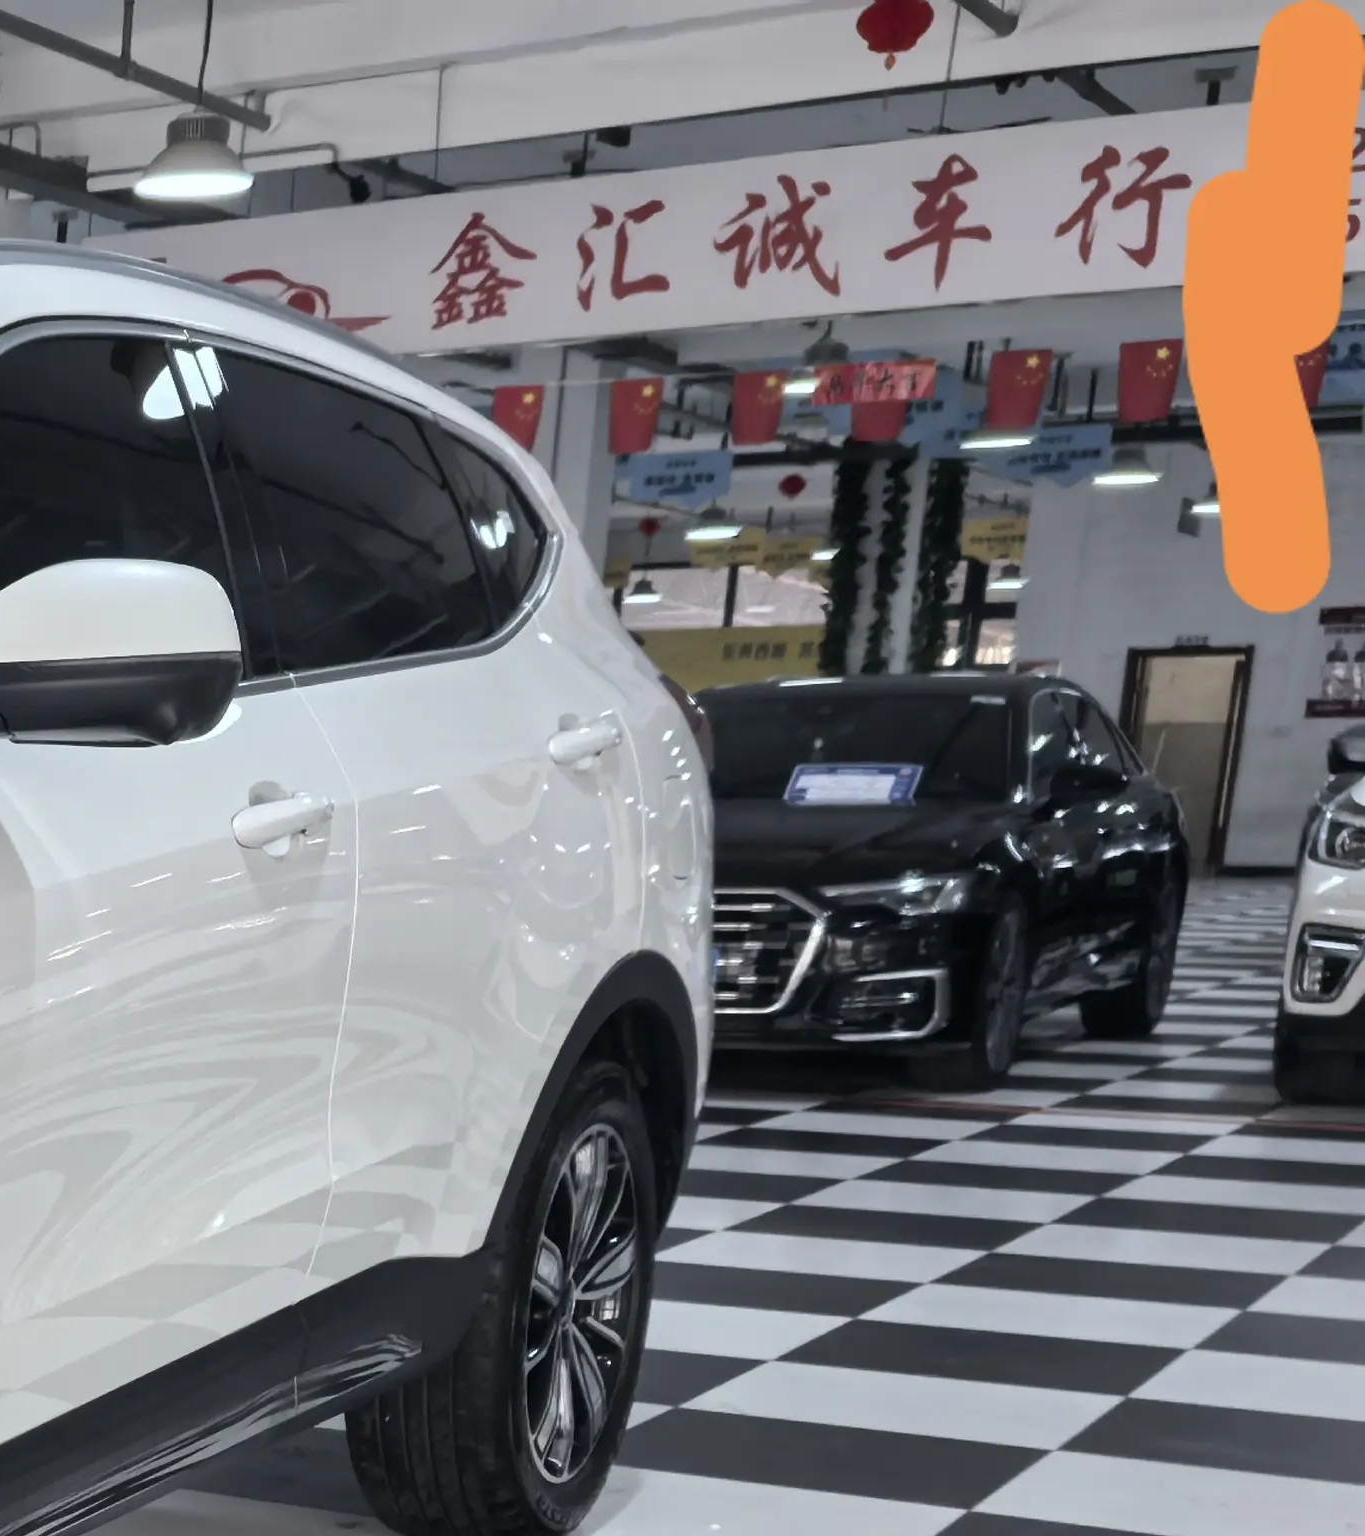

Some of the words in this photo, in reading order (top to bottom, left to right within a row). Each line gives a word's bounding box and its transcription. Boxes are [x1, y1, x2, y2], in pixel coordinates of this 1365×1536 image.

[429, 145, 1192, 330] 鑫汇诚车行
